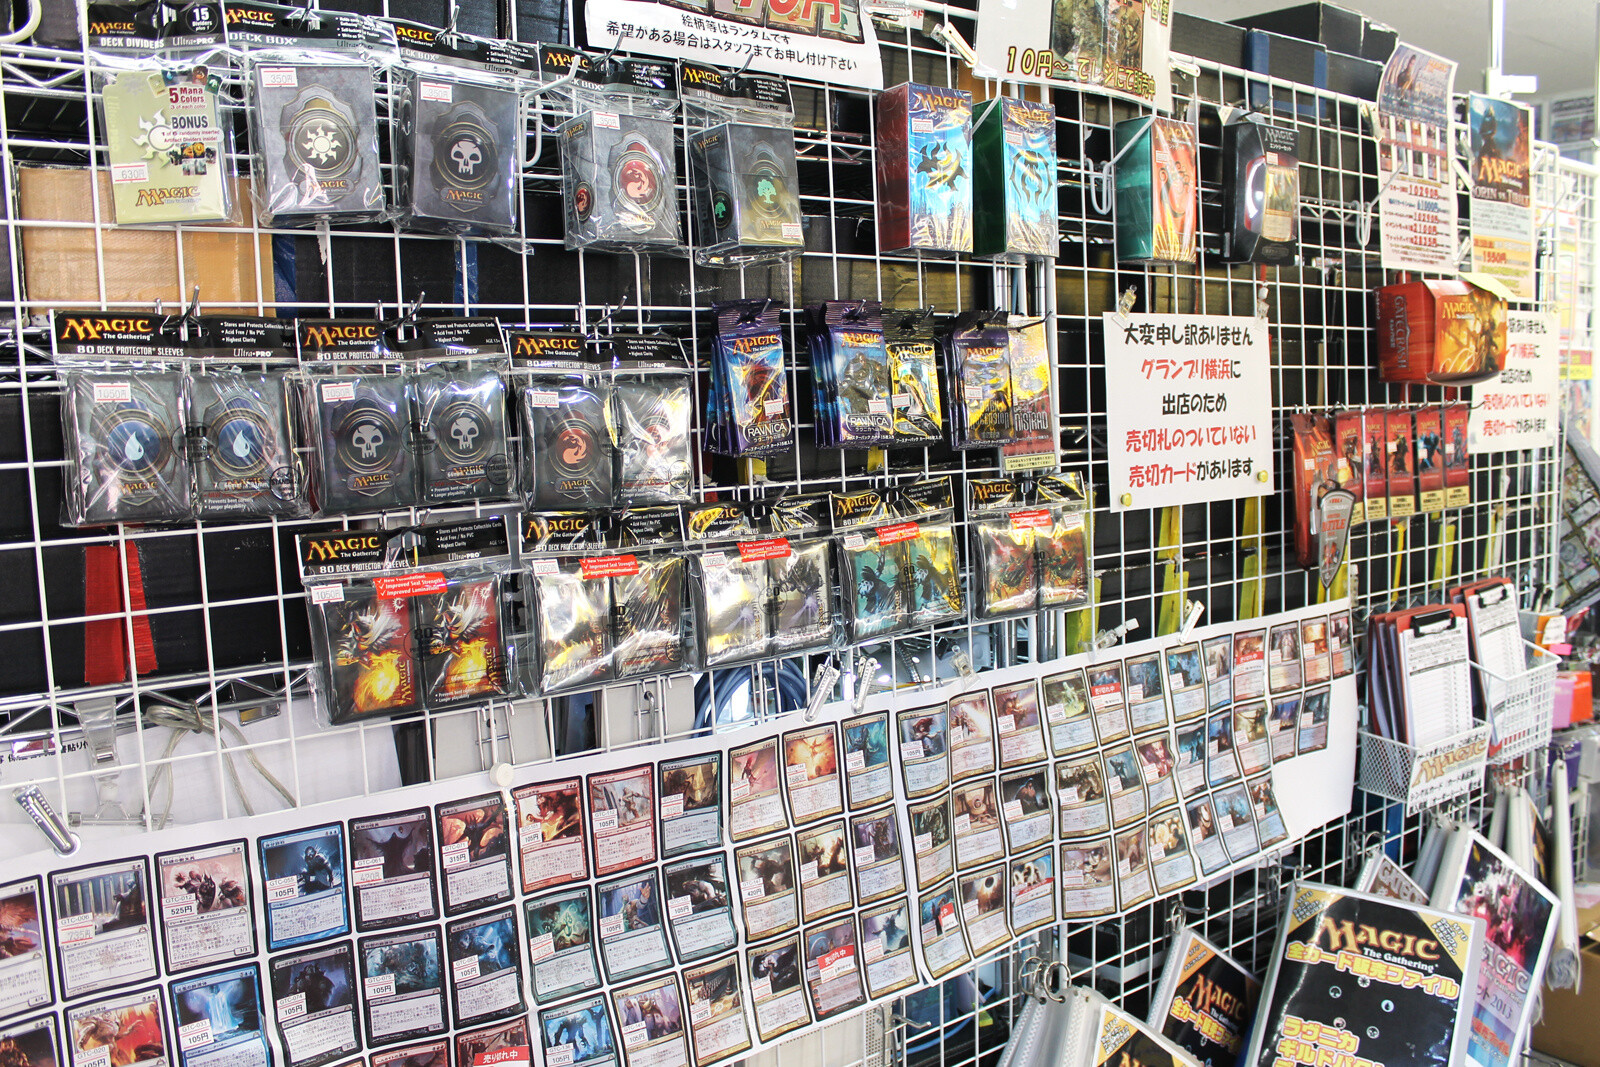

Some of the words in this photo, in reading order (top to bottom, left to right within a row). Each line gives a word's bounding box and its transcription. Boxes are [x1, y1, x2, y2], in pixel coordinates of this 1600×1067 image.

[192, 7, 210, 20] 15
[225, 8, 276, 24] MAGIC
[89, 22, 135, 34] MAGIC
[396, 26, 435, 42] AGIC
[100, 37, 124, 47] DECK
[126, 37, 165, 49] DIVIDERS
[229, 32, 262, 42] DECK
[410, 38, 435, 48] Gathering
[606, 19, 858, 71] 希望がある場合はスタッフまでお申し付け下さい
[682, 66, 722, 84] MAGIC
[169, 88, 179, 104] 5
[180, 86, 204, 95] Mana
[180, 95, 205, 103] Colors
[912, 92, 968, 112] MAGIC
[171, 116, 208, 129] BONUS
[1264, 128, 1295, 142] MAGIC
[1478, 156, 1524, 184] MAGIC
[136, 186, 200, 206] MAGIC
[446, 188, 484, 200] MAGIC
[1442, 301, 1475, 320] MAGIC
[60, 318, 152, 340] MAGIC
[1124, 322, 1254, 346] 大変申し訳ありません
[116, 332, 150, 341] Gathering
[304, 326, 378, 347] MAGIC
[842, 332, 881, 347] MAGIC
[514, 336, 580, 356] MAGIC
[732, 334, 778, 354] MAGIC
[77, 345, 95, 354] 80
[97, 345, 114, 355] DECK
[157, 347, 184, 357] SLEEVES
[316, 352, 331, 360] 80
[332, 352, 348, 360] DECK
[1140, 358, 1242, 380] グランプリ横浜に
[1162, 392, 1228, 416] 出店のため
[850, 416, 889, 426] RAVNICA
[747, 423, 788, 438] RAVNICA
[1126, 424, 1256, 453] 売切札のついていない
[1128, 457, 1254, 488] 売切カードがあります
[118, 481, 158, 494] MAGIC
[352, 474, 390, 488] MAGIC
[560, 480, 591, 490] MAGIC
[973, 483, 1012, 501] MAGIC
[836, 494, 877, 516] MAGIC
[526, 518, 584, 540] MAGIC
[306, 536, 382, 561] MAGIC
[320, 566, 334, 574] 80
[336, 564, 351, 572] DECK
[386, 588, 410, 596] Improved
[399, 661, 412, 701] MAGIC
[598, 820, 616, 828] 105円
[525, 833, 539, 842] 105円
[444, 842, 466, 852] GTC-071
[358, 858, 382, 867] GTC-061
[449, 853, 466, 864] 315円
[270, 876, 296, 887] GTC-055
[165, 894, 193, 904] GTC-012
[274, 887, 295, 898] 105円
[170, 905, 193, 916] 525円
[674, 906, 690, 914] 105円
[60, 914, 90, 926] GTC-006
[606, 924, 622, 933] 105円
[1308, 917, 1440, 961] MAGIC
[1363, 948, 1382, 960] The
[1384, 952, 1434, 974] Gathering
[460, 967, 477, 977] 105円
[1285, 940, 1460, 1000] 全カード販売ファイル
[1482, 942, 1528, 994] AGIC
[372, 986, 392, 994] 105円
[1187, 972, 1246, 1020] MAGIC
[279, 994, 303, 1006] GTC-074
[284, 1004, 304, 1016] 105円
[1490, 994, 1513, 1020] 2013
[696, 1010, 709, 1020] 105円
[182, 1020, 208, 1033] GTC-033
[188, 1032, 209, 1045] 105円
[629, 1032, 646, 1043] 105円
[1281, 1014, 1360, 1054] ラヴニカ
[77, 1046, 106, 1060] GTC-020
[482, 1050, 518, 1064] 売り切れ中
[552, 1054, 570, 1064] 105円
[1276, 1038, 1386, 1067] ギルドパ
